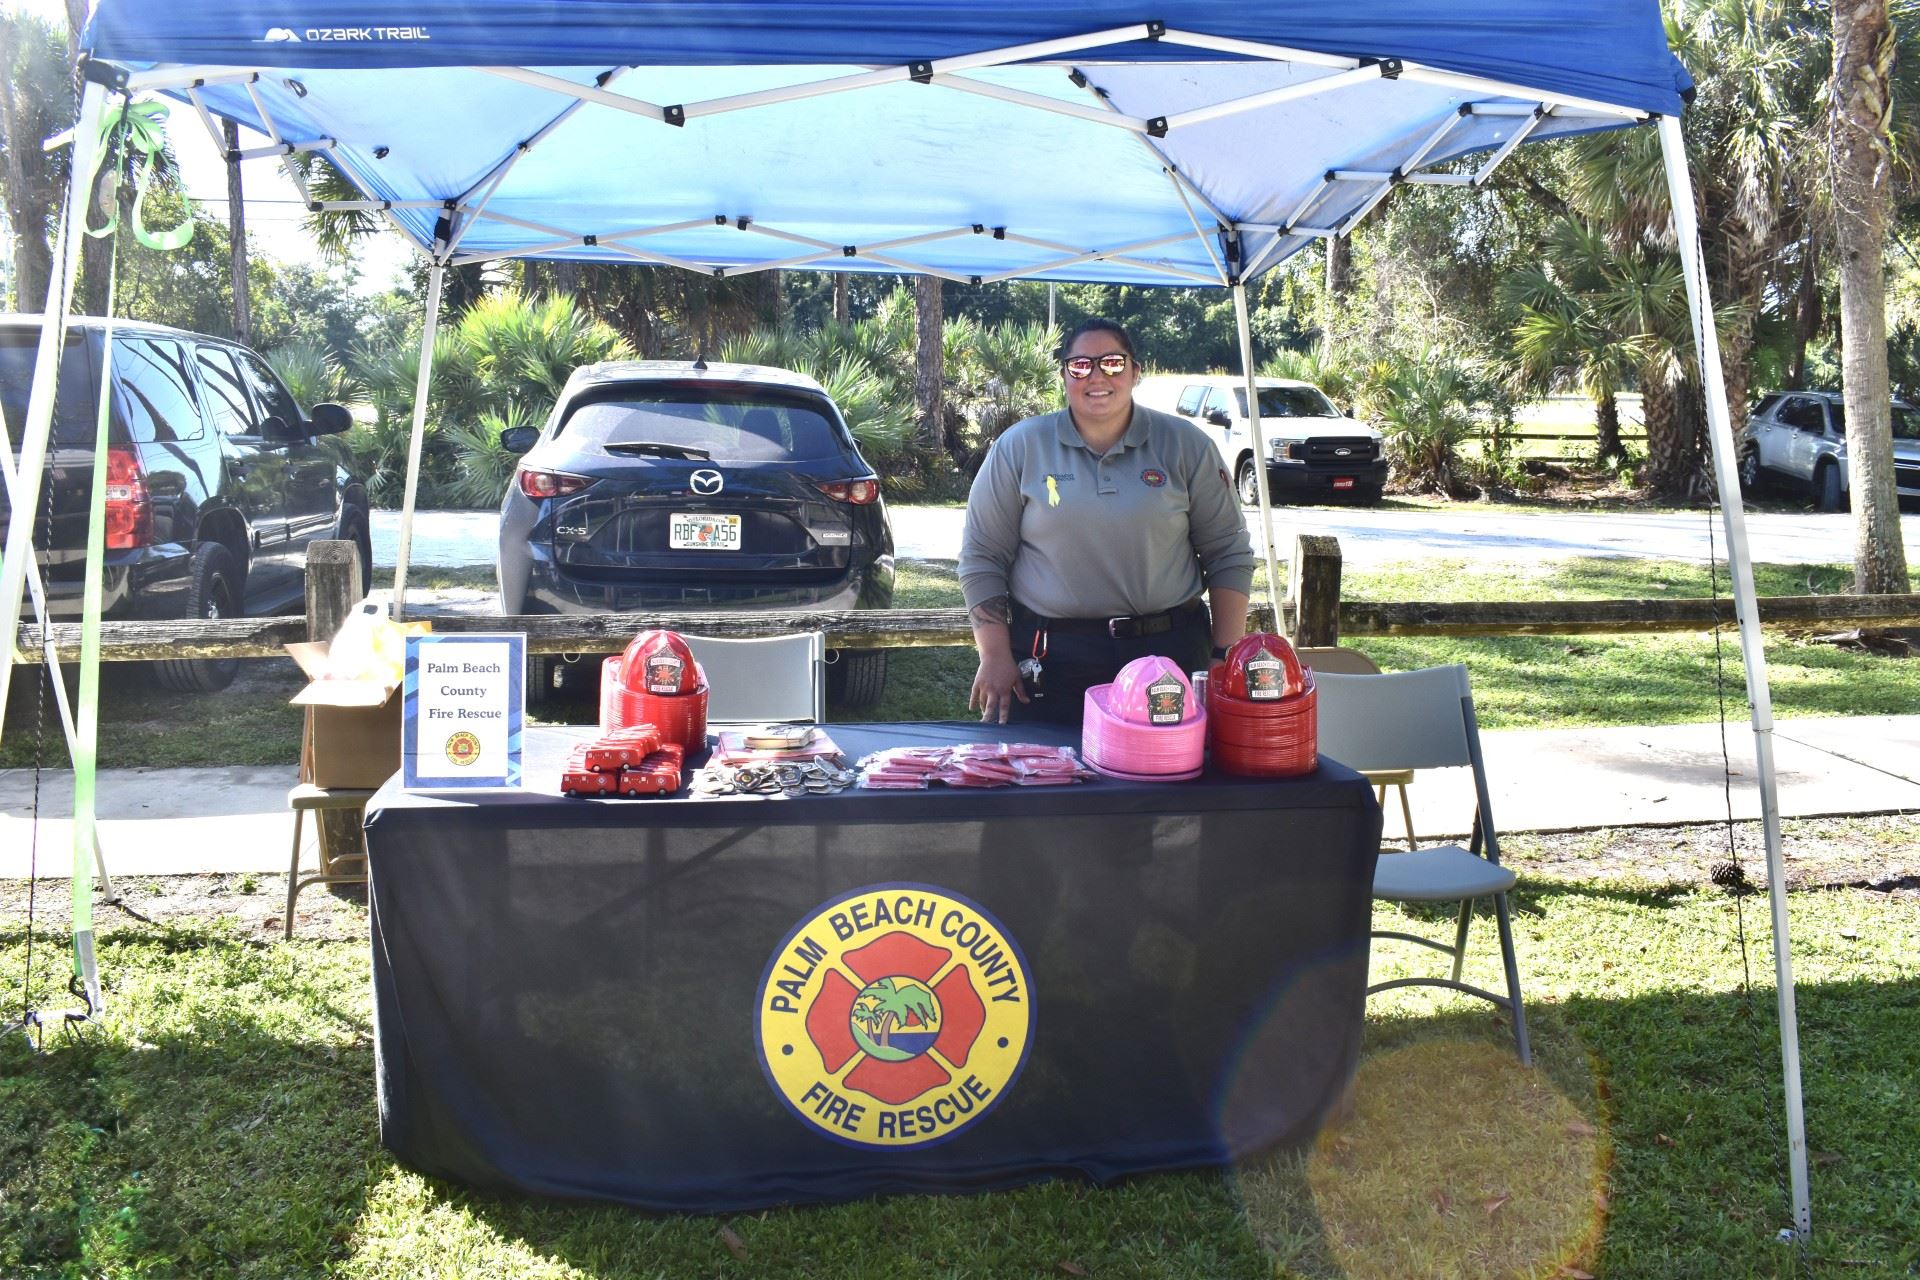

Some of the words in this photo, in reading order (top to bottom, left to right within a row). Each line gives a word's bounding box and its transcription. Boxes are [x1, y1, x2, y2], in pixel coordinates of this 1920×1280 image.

[556, 526, 587, 535] CX-5
[674, 523, 698, 541] RBF
[713, 524, 737, 542] A56
[427, 662, 459, 674] Palm
[462, 662, 501, 674] Beach
[440, 685, 487, 698] County
[428, 708, 454, 719] Fire
[458, 708, 502, 719] Rescue
[770, 936, 828, 1014] PALM
[828, 896, 937, 942] BEACH
[940, 910, 1021, 1003] COUNTY
[800, 1081, 866, 1132] FIRE
[877, 1074, 992, 1138] RESCUE
